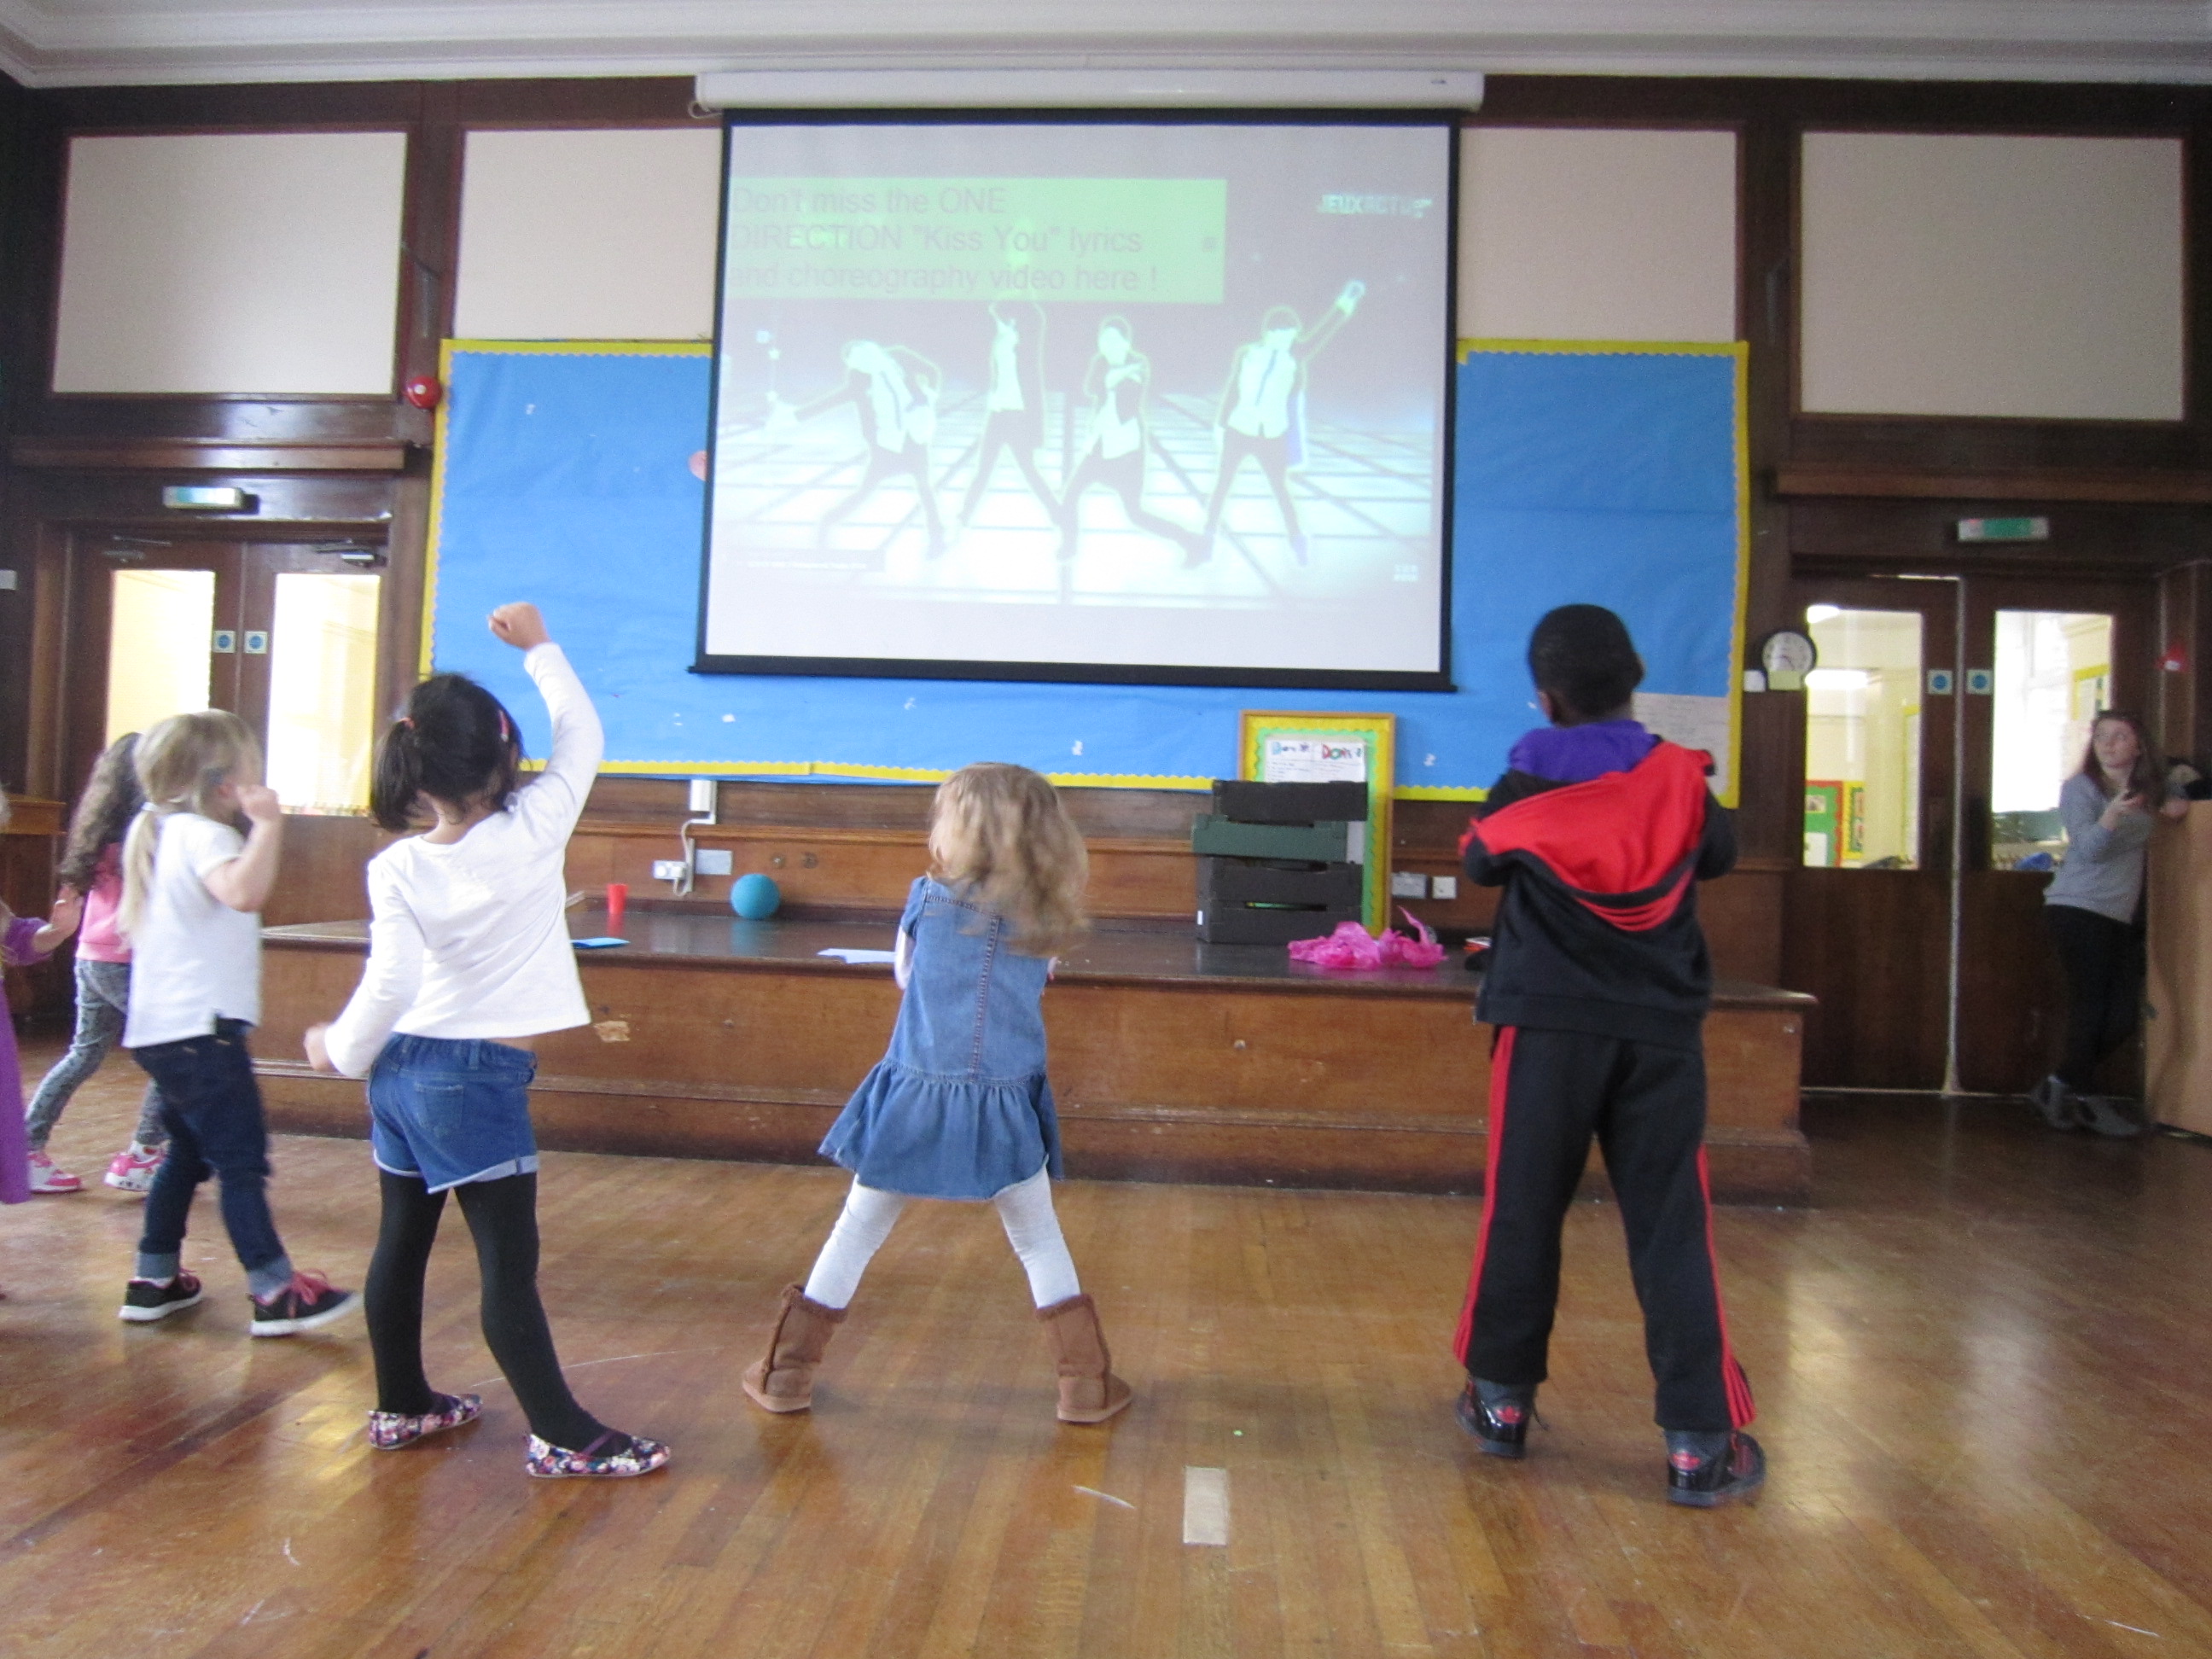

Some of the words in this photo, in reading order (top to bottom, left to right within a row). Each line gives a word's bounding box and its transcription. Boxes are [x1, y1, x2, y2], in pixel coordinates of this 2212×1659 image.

[733, 187, 802, 213] Don't
[812, 187, 876, 214] miss
[886, 187, 929, 214] the
[939, 187, 1007, 214] ONE
[731, 224, 902, 251] DIRECTION
[912, 224, 983, 252] "Kiss
[993, 225, 1062, 252] You"
[1068, 225, 1143, 259] lyrics
[729, 261, 778, 288] and
[788, 261, 979, 294] choreography
[989, 264, 1066, 290] video
[1074, 264, 1139, 291] here
